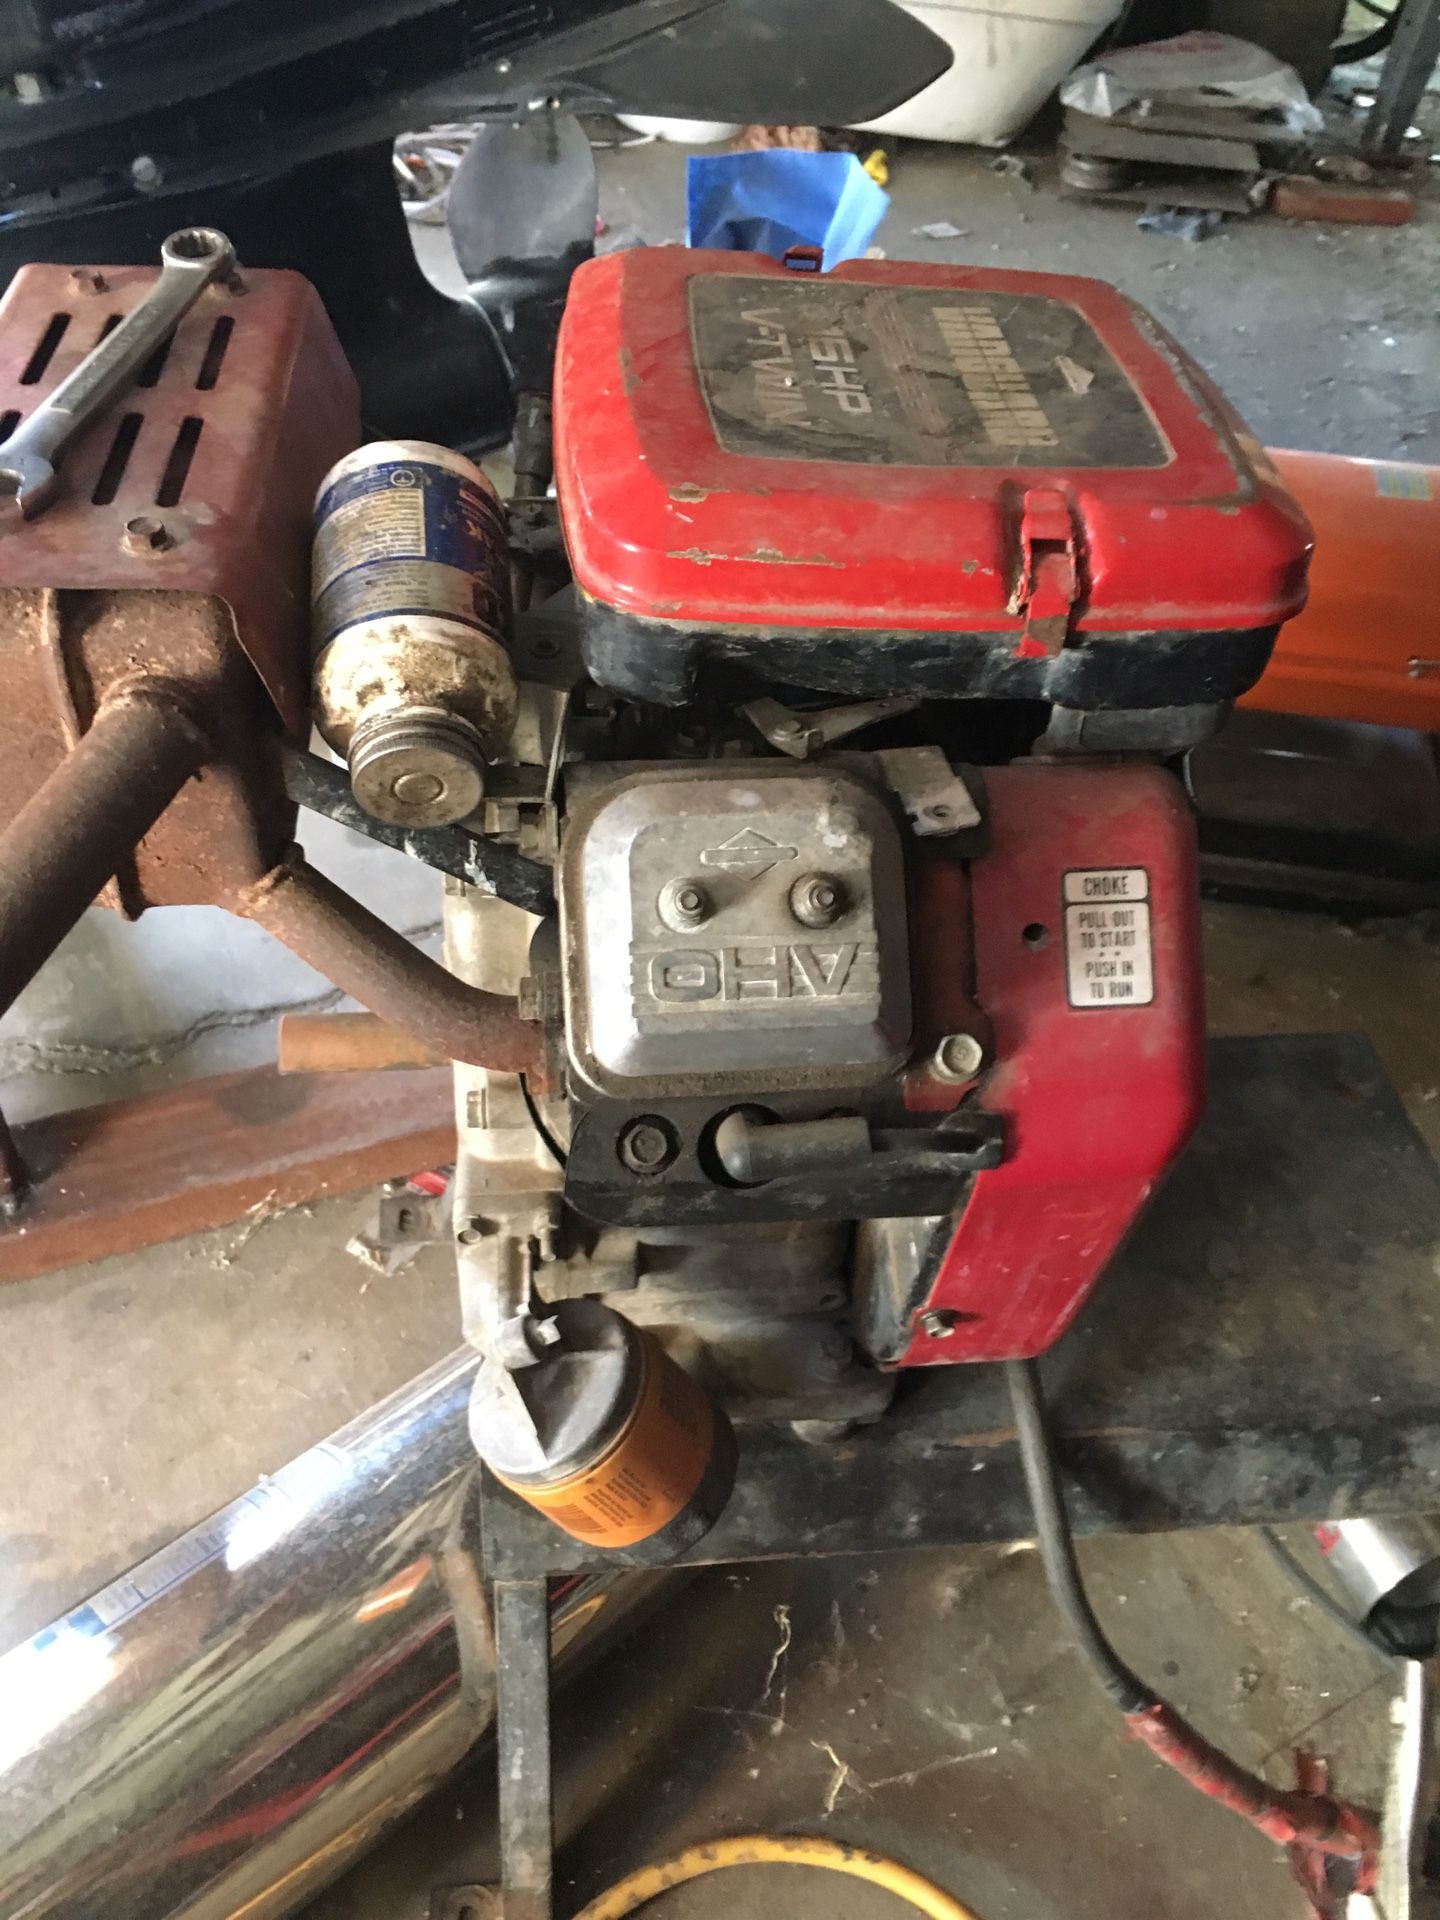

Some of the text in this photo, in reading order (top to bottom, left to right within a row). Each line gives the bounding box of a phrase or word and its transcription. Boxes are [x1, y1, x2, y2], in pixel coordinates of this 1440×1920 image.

[1083, 875, 1129, 896] CHOKE
[1079, 910, 1135, 928] PULL OUT
[1080, 930, 1136, 948] TO START
[648, 942, 860, 1004] OHV
[1085, 959, 1134, 978] PUSH IN
[1090, 982, 1133, 999] TO RUN
